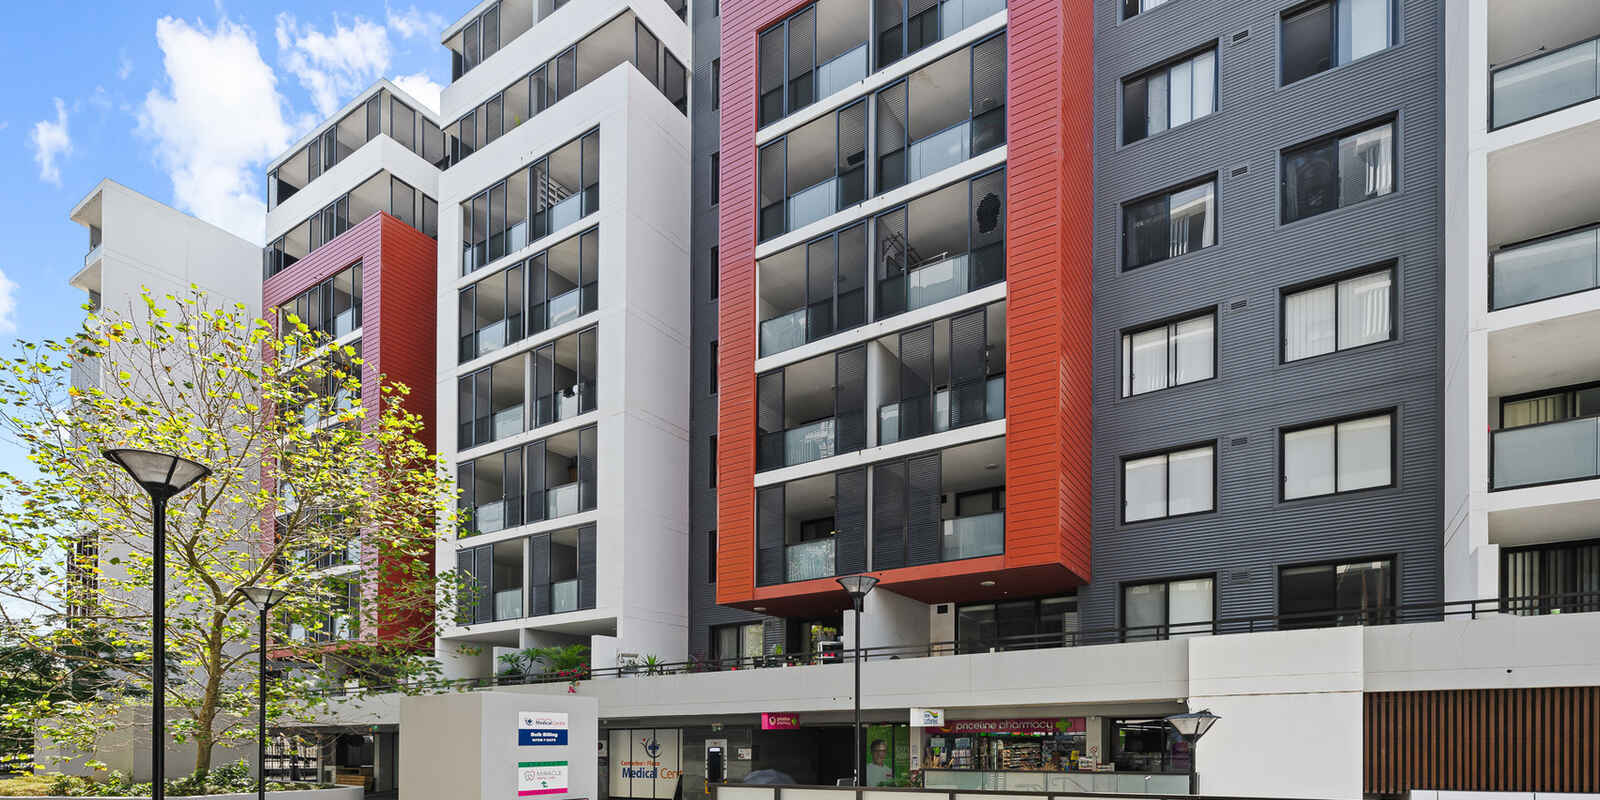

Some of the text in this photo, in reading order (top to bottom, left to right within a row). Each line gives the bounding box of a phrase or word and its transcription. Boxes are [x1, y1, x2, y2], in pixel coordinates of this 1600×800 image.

[956, 719, 1053, 731] priceline pharmacy
[622, 767, 658, 779] Medical
